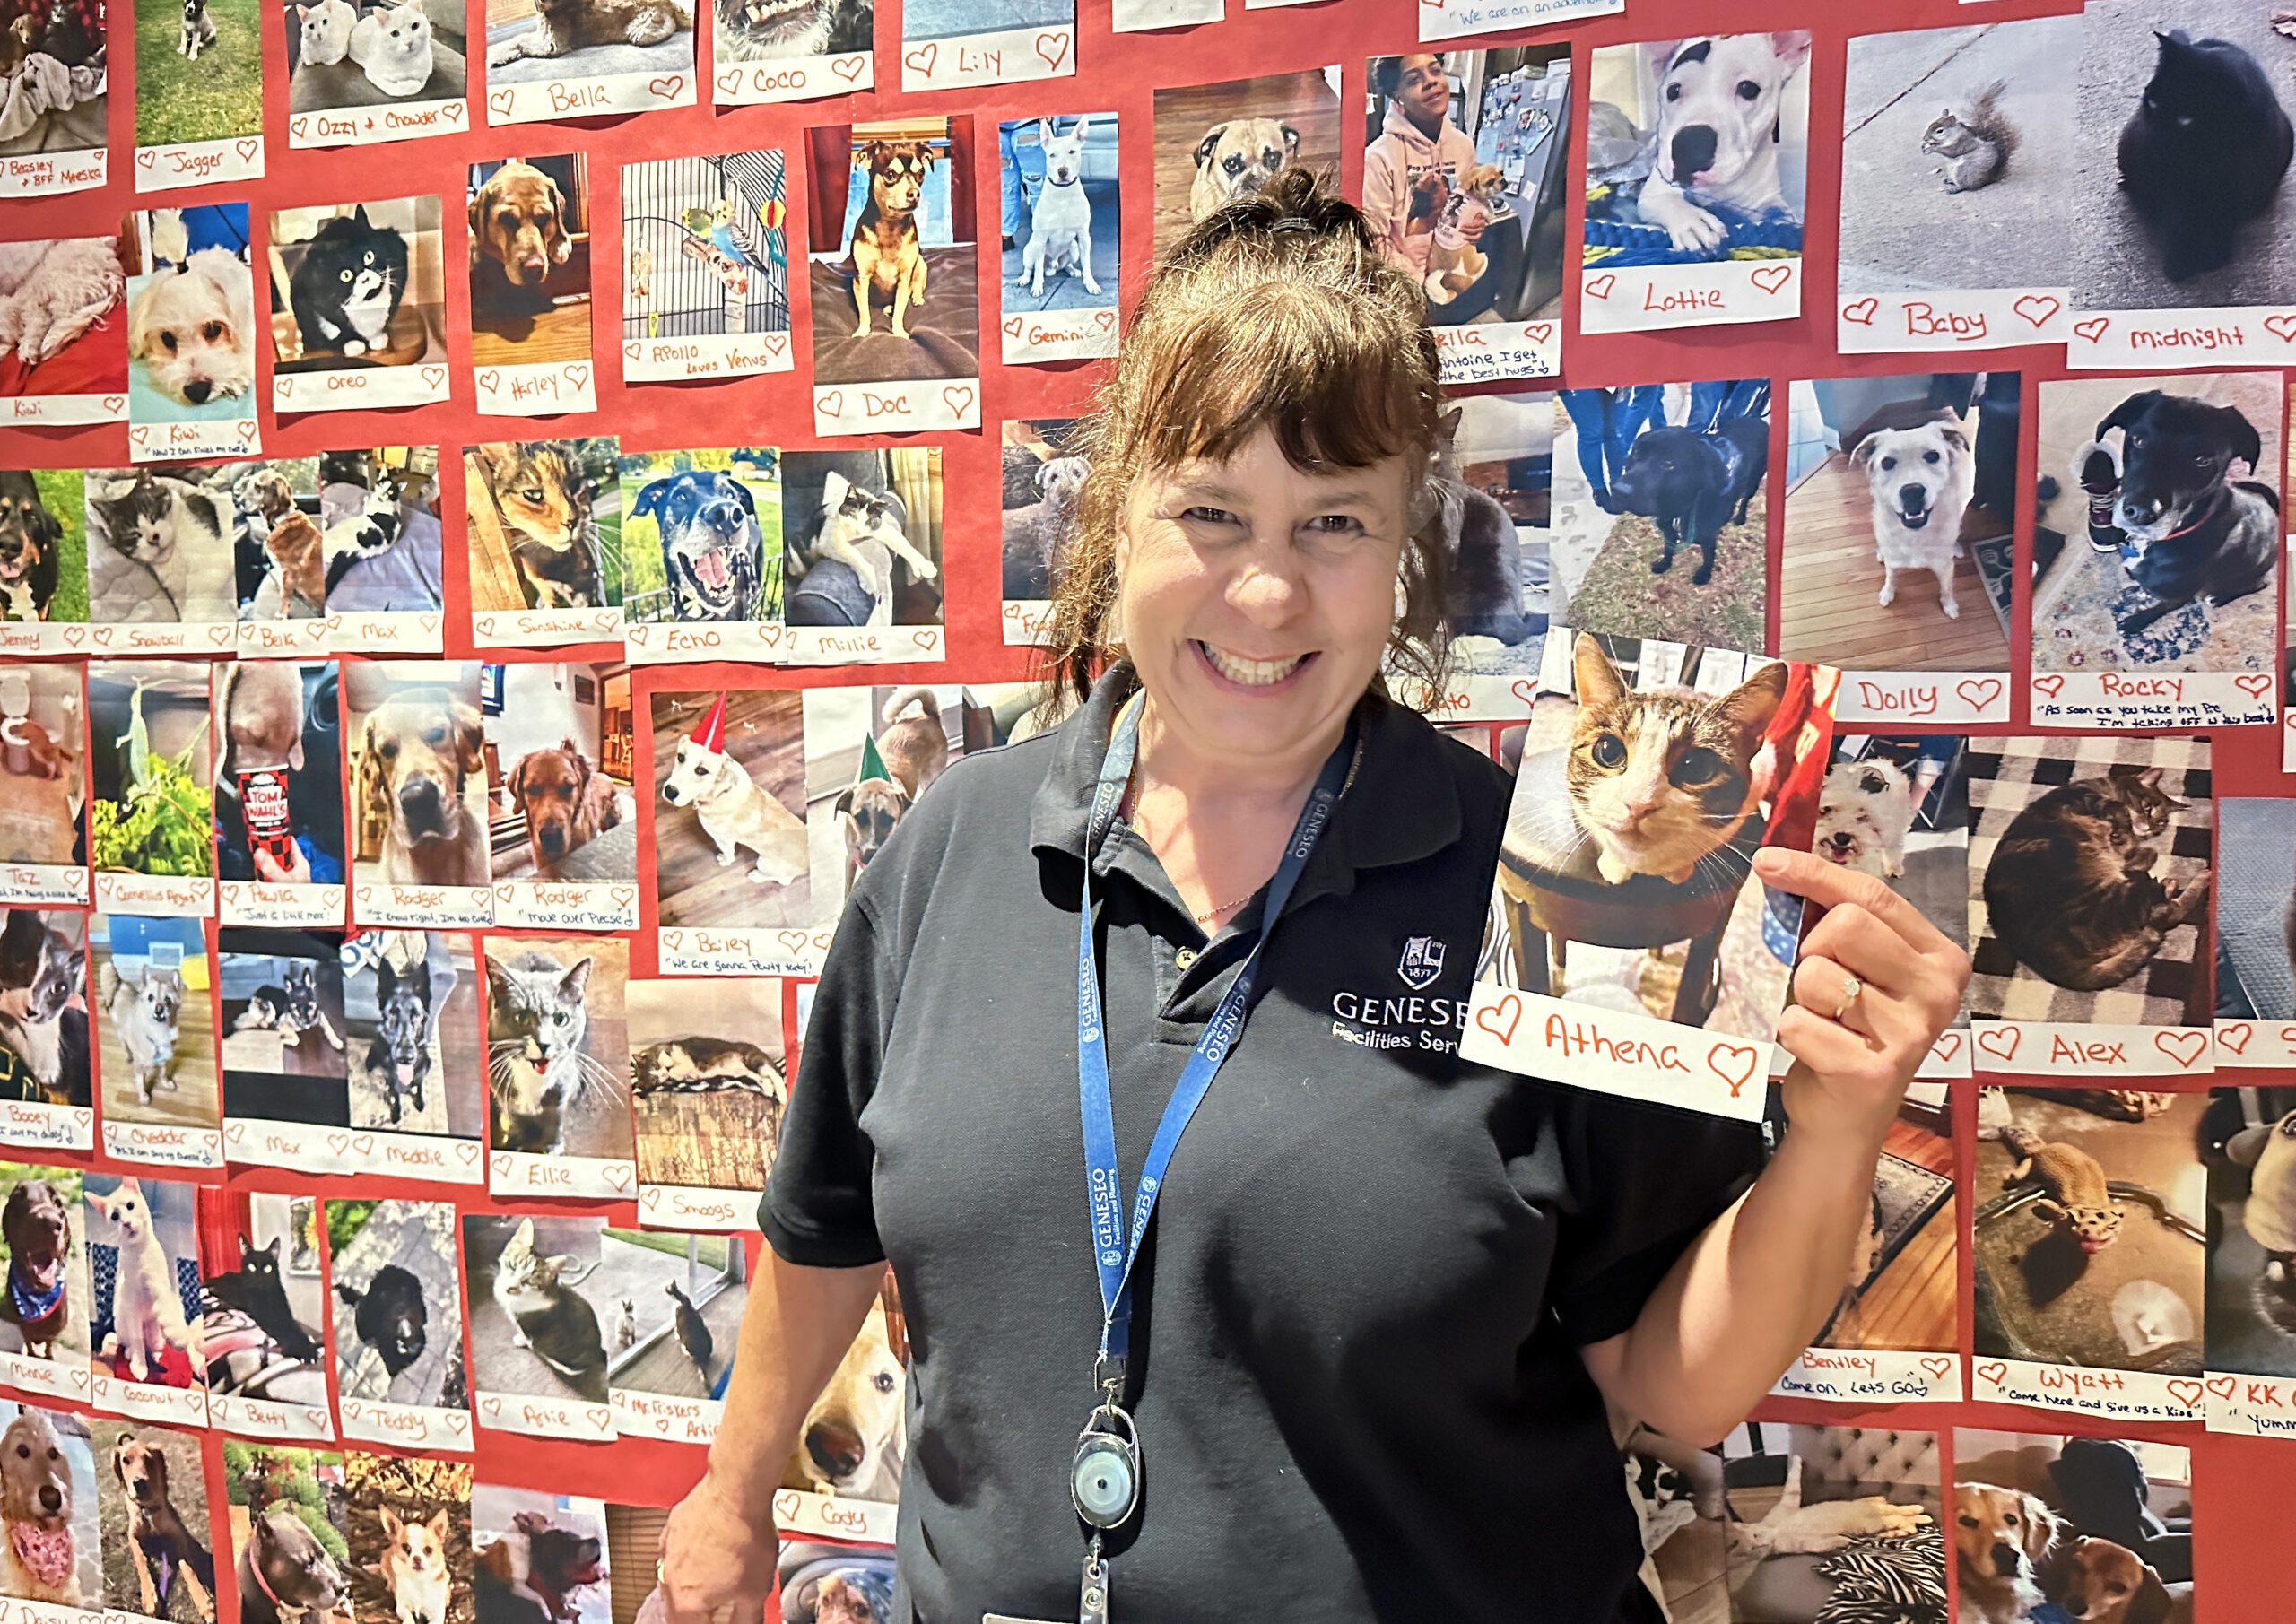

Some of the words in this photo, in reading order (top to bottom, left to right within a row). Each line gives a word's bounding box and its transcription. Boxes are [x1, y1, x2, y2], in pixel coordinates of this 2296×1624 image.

[1489, 6, 1510, 19] are
[1512, 4, 1527, 16] on
[1533, 3, 1551, 14] an
[959, 48, 1002, 76] Lily
[547, 83, 612, 113] Bella
[386, 111, 438, 129] Chowder
[9, 160, 54, 176] Beasley
[163, 151, 224, 177] Jagger
[33, 175, 53, 187] BFF
[1643, 283, 1726, 312] Lottie
[1902, 301, 1987, 341] Baby
[1029, 325, 1084, 346] Gemini
[1434, 329, 1487, 348] ella
[726, 347, 768, 370] Venus
[1500, 351, 1510, 362] I
[1513, 349, 1538, 362] get
[1472, 368, 1500, 380] best
[510, 373, 559, 402] Harley
[14, 399, 43, 417] Kiwi
[170, 423, 200, 444] Kiwi
[518, 615, 587, 634] Sunshine
[0, 630, 40, 651] Jenny
[130, 631, 185, 648] Snowball
[262, 630, 299, 648] Bella
[1858, 681, 1938, 716] Dolly
[2099, 673, 2183, 702] Rocky
[2066, 706, 2093, 716] soon
[2096, 706, 2112, 715] as
[2118, 706, 2138, 717] you
[2141, 705, 2171, 715] take
[2178, 706, 2198, 716] my
[2132, 718, 2173, 728] taking
[251, 790, 278, 804] TOM
[1091, 781, 1115, 840] GENESEO
[1295, 803, 1330, 859] GENESEO
[391, 886, 447, 908] Rodger
[534, 884, 594, 908] Rodger
[561, 912, 586, 925] over
[695, 932, 752, 956] Bailey
[691, 960, 709, 969] are
[715, 960, 748, 972] gonna
[1081, 957, 1091, 1028] GENESEO
[1332, 991, 1469, 1030] GENESE
[1206, 994, 1247, 1063] GENESEO
[1331, 1020, 1412, 1051] Facilities
[1418, 1030, 1461, 1055] Serv
[1545, 1012, 1692, 1073] Athena
[2050, 1033, 2128, 1064] Alex
[528, 1163, 574, 1186] Ellie
[1108, 1168, 1118, 1199] Planning
[1092, 1168, 1113, 1248] GENESEO
[1109, 1199, 1118, 1213] and
[1111, 1211, 1122, 1246] Facilities
[1802, 1350, 1875, 1378] Bentley
[1781, 1376, 1814, 1394] Come
[1851, 1381, 1885, 1394] Lets
[2040, 1367, 2125, 1395] Wyatt
[123, 1385, 174, 1405] Coconut
[2043, 1393, 2074, 1407] here
[2079, 1397, 2101, 1410] and
[2134, 1405, 2149, 1415] us
[2152, 1407, 2161, 1415] a
[2248, 1383, 2283, 1408] KK
[245, 1403, 289, 1430] Betty
[367, 1409, 428, 1441] Teddy
[523, 1404, 570, 1427] Artie
[821, 1501, 867, 1534] Cody
